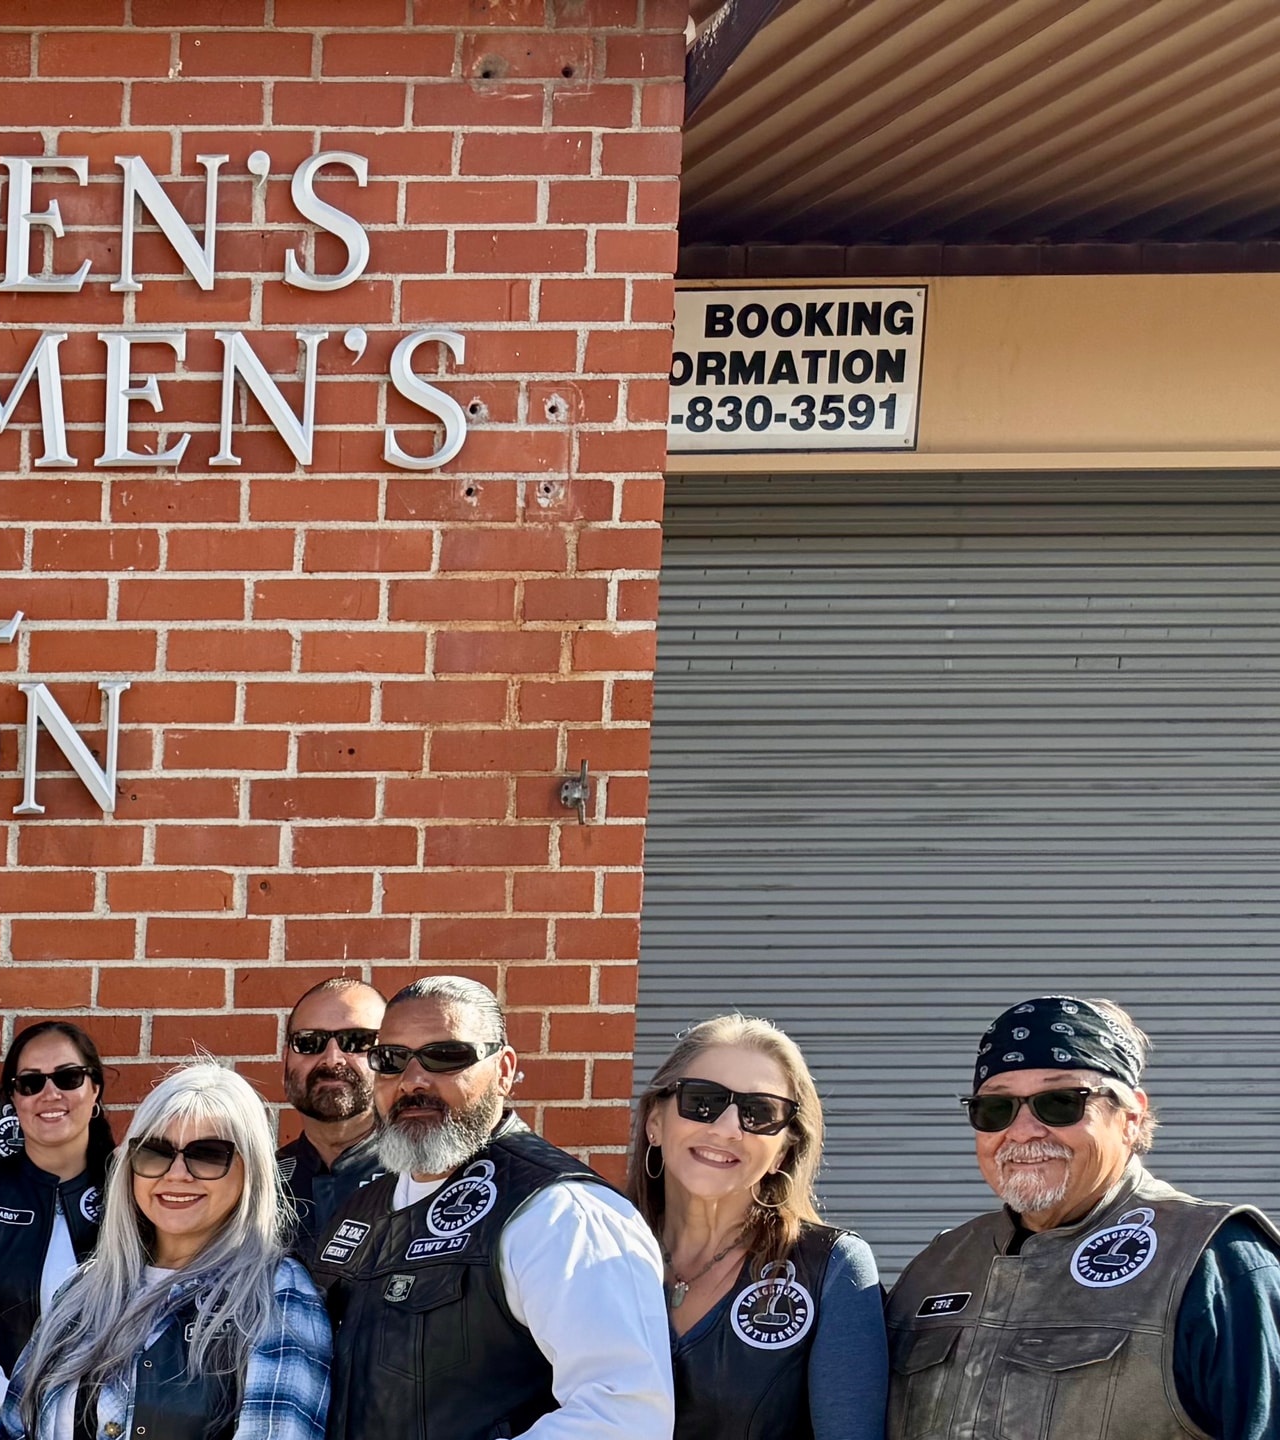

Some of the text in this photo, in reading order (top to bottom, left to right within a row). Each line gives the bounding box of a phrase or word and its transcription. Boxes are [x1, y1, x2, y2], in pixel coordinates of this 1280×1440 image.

[704, 301, 914, 338] BOOKING
[411, 1238, 463, 1254] ILWU 13
[742, 1285, 803, 1308] LONGSHORE
[738, 1308, 806, 1342] BROTHERHOOD
